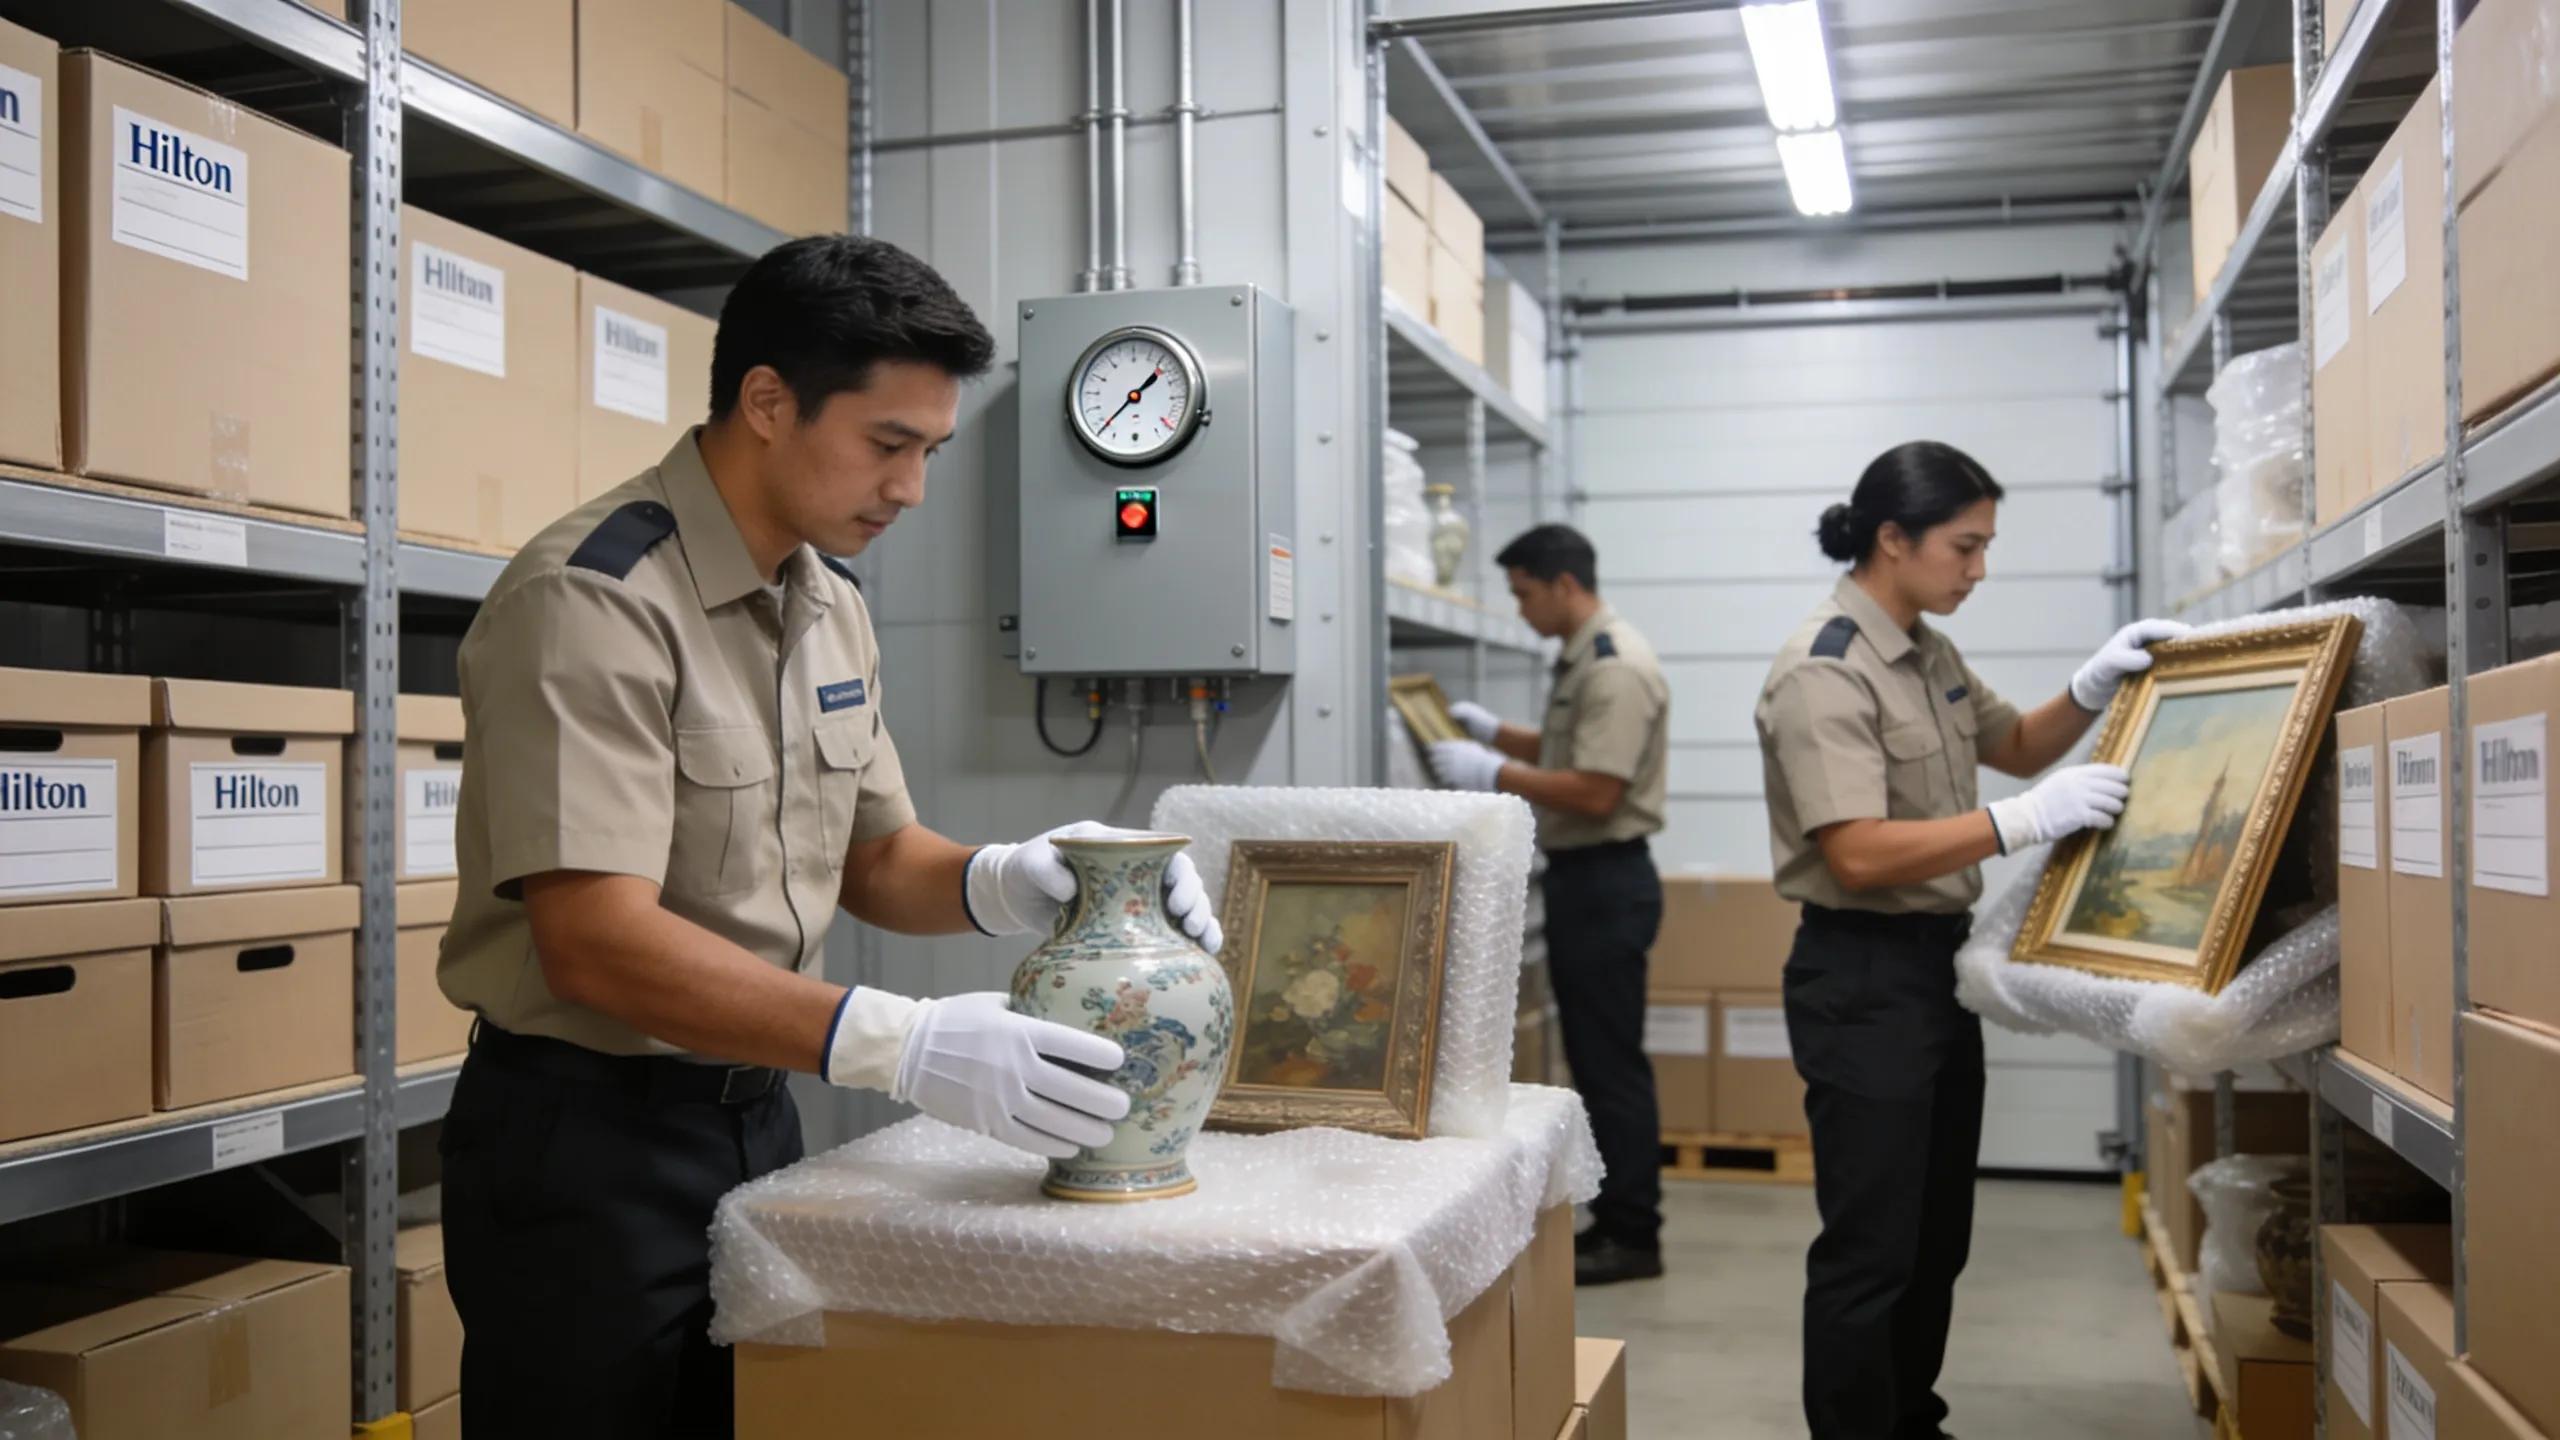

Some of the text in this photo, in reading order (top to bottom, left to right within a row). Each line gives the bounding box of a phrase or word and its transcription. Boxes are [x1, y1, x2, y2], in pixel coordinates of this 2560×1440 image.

[130, 122, 232, 193] Hilton
[215, 774, 300, 809] Hilton
[424, 781, 459, 808] Hil
